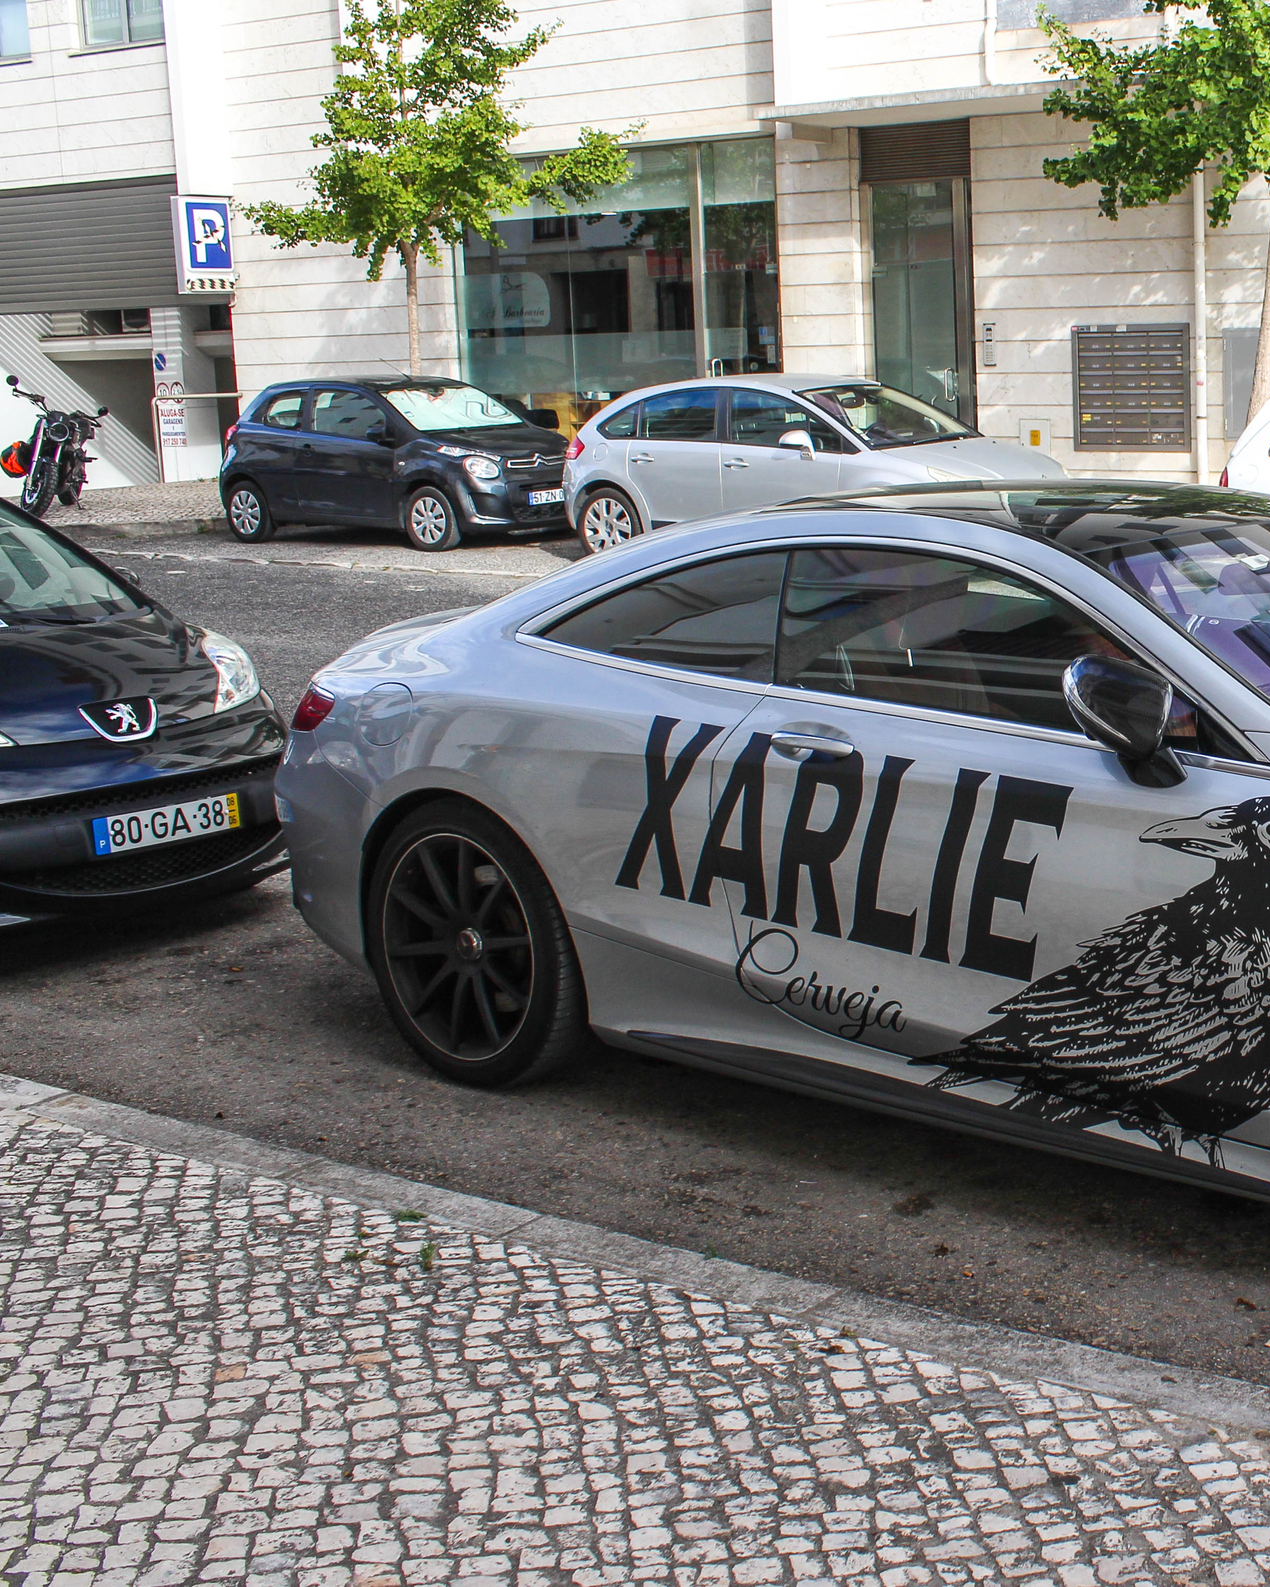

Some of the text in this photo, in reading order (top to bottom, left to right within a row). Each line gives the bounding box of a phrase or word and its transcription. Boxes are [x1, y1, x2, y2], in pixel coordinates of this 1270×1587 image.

[193, 209, 225, 263] P
[99, 840, 107, 849] P
[615, 715, 1075, 983] XARLIE
[735, 920, 907, 1040] Cerveja
